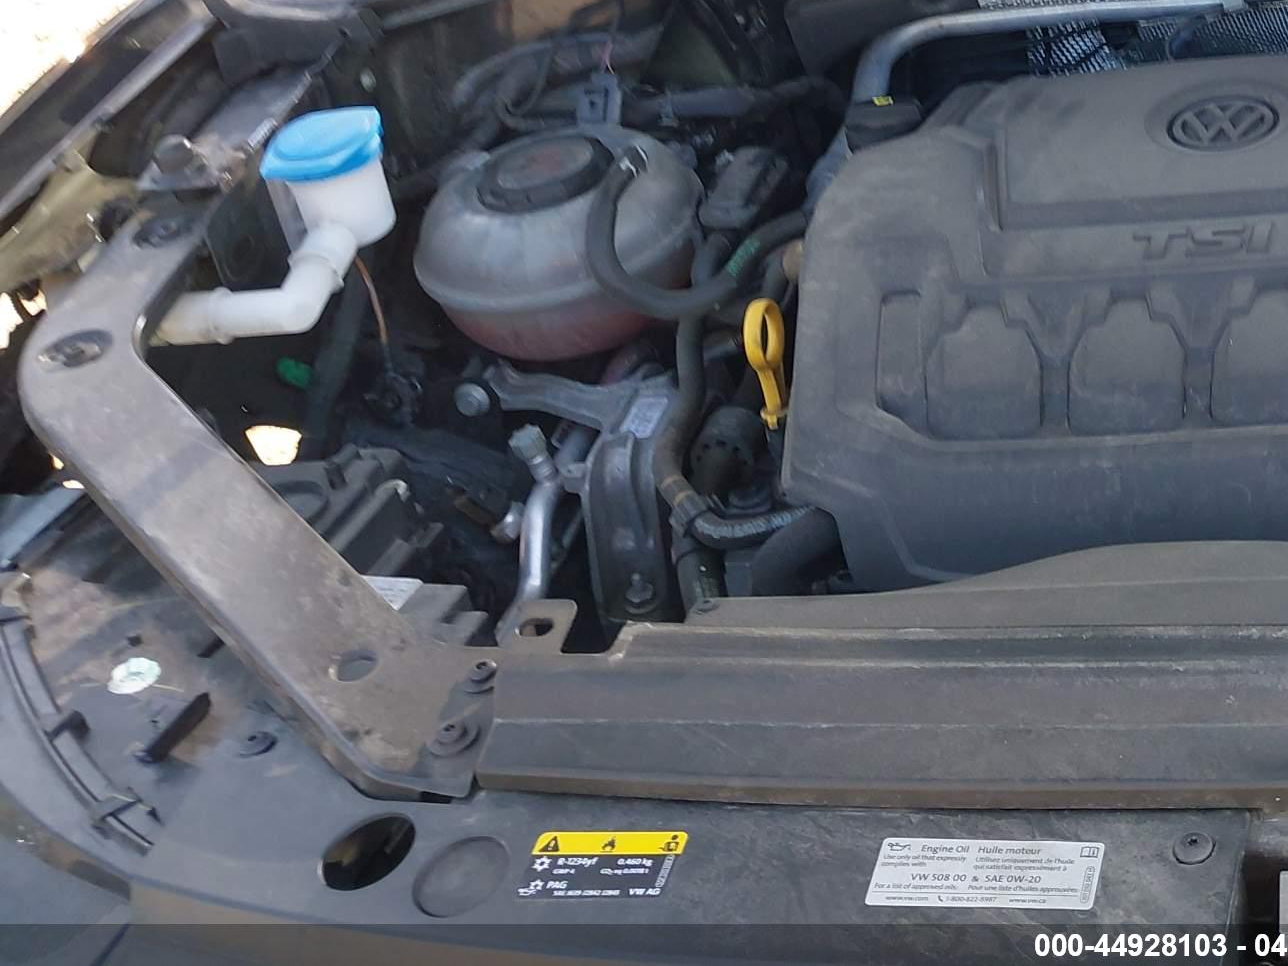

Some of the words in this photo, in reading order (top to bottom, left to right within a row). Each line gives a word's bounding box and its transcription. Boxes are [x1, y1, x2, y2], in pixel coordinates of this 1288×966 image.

[1132, 220, 1275, 260] TSI
[920, 844, 954, 854] Engine
[955, 845, 970, 853] Oil
[977, 845, 1004, 854] Huile
[1005, 847, 1041, 855] moteur
[911, 873, 930, 881] VW
[931, 873, 950, 881] 508
[952, 874, 967, 882] 00
[984, 874, 1004, 883] SAE
[1006, 875, 1042, 884] 0W-20
[546, 881, 568, 889] PAG
[646, 888, 661, 896] AG
